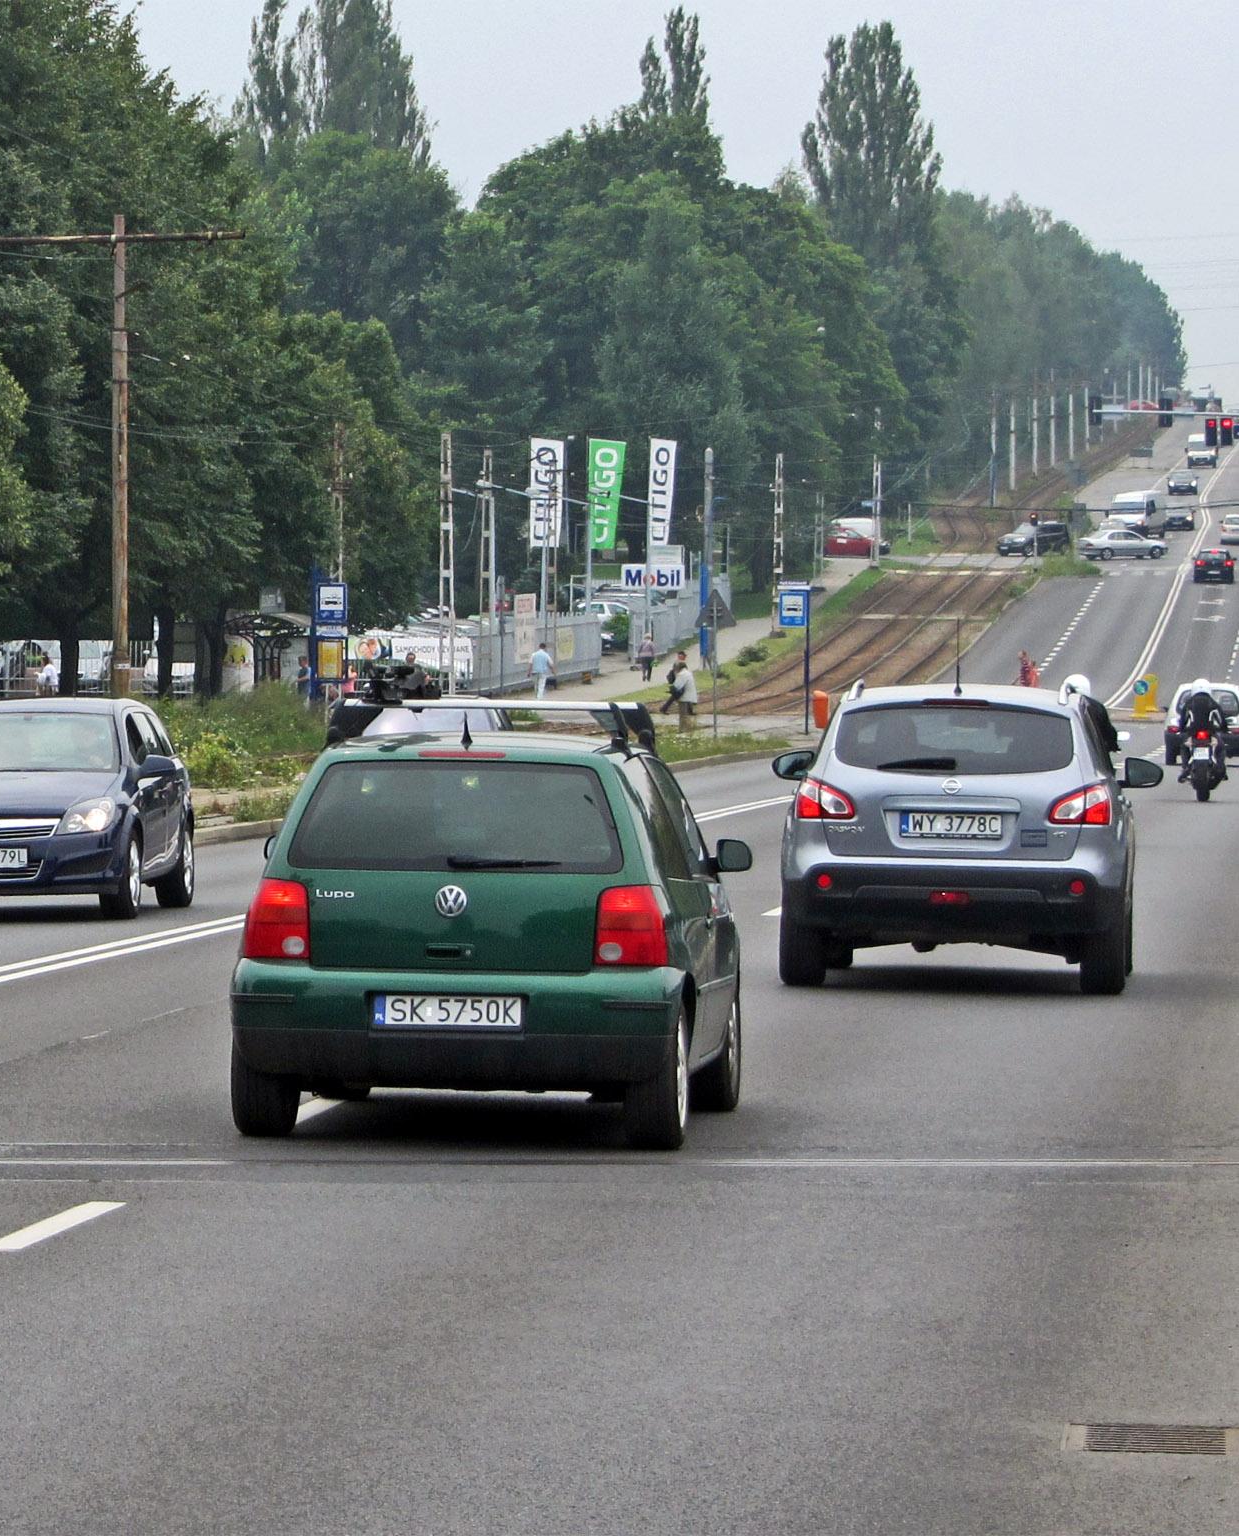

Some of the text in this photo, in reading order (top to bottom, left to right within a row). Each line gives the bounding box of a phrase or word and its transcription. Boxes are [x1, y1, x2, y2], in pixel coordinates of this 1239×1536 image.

[625, 569, 681, 587] Mobil
[912, 814, 937, 832] WY
[944, 815, 999, 833] 3778C
[315, 888, 355, 899] Lupo
[390, 997, 426, 1023] SK
[437, 998, 518, 1024] 5750K
